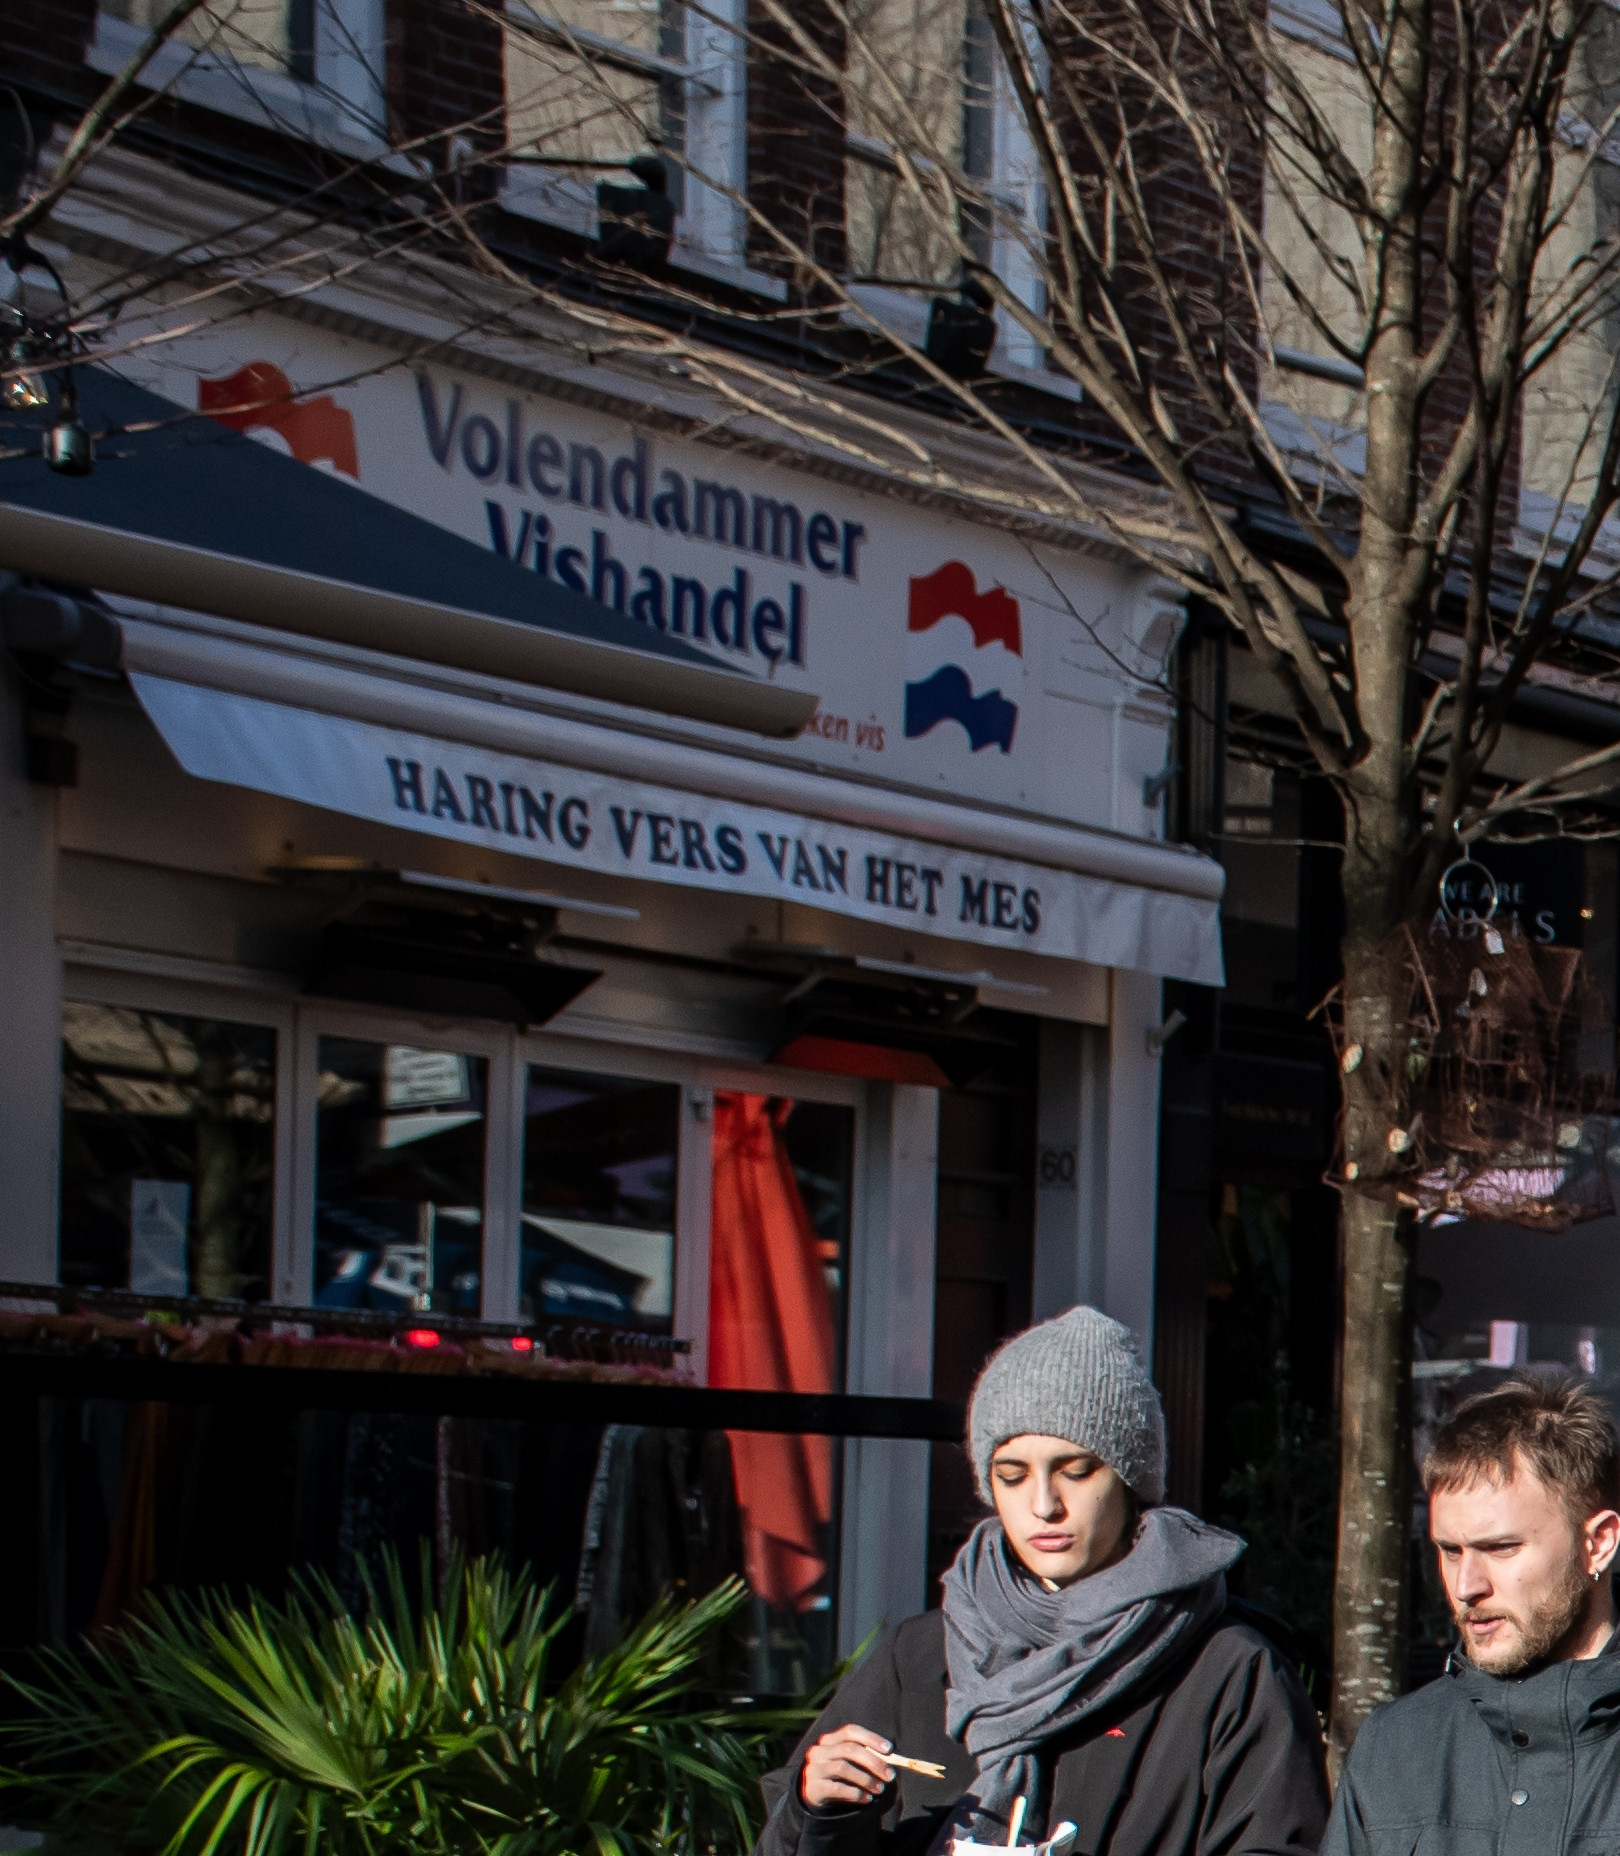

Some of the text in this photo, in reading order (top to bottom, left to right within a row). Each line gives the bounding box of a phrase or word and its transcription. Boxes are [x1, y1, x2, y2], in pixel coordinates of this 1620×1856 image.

[415, 373, 866, 582] Volendammer
[486, 500, 806, 665] Vishandel
[385, 757, 1041, 934] HARING VERS VAN HET MES
